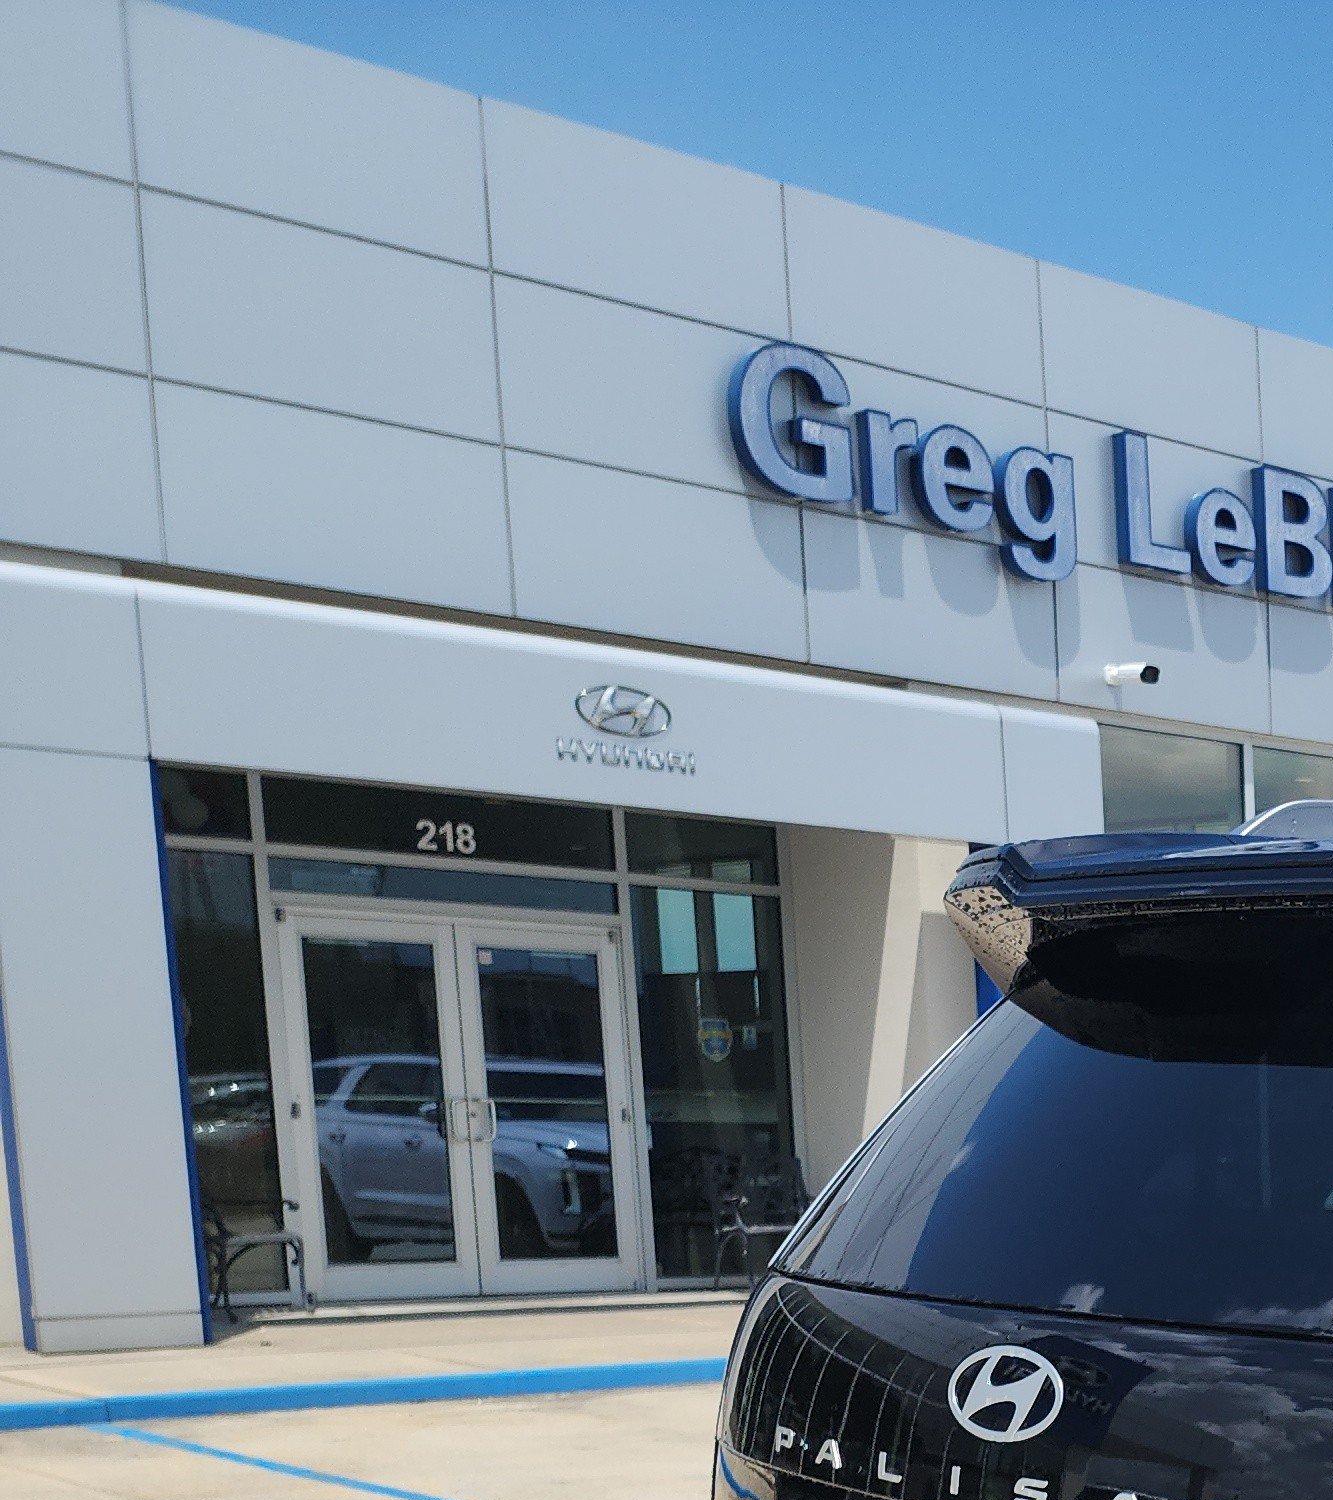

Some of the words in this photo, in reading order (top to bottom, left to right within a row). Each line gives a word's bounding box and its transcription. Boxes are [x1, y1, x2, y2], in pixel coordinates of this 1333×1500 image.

[729, 342, 1078, 582] Greg
[556, 737, 696, 775] HYUNDAI
[416, 819, 477, 855] 218
